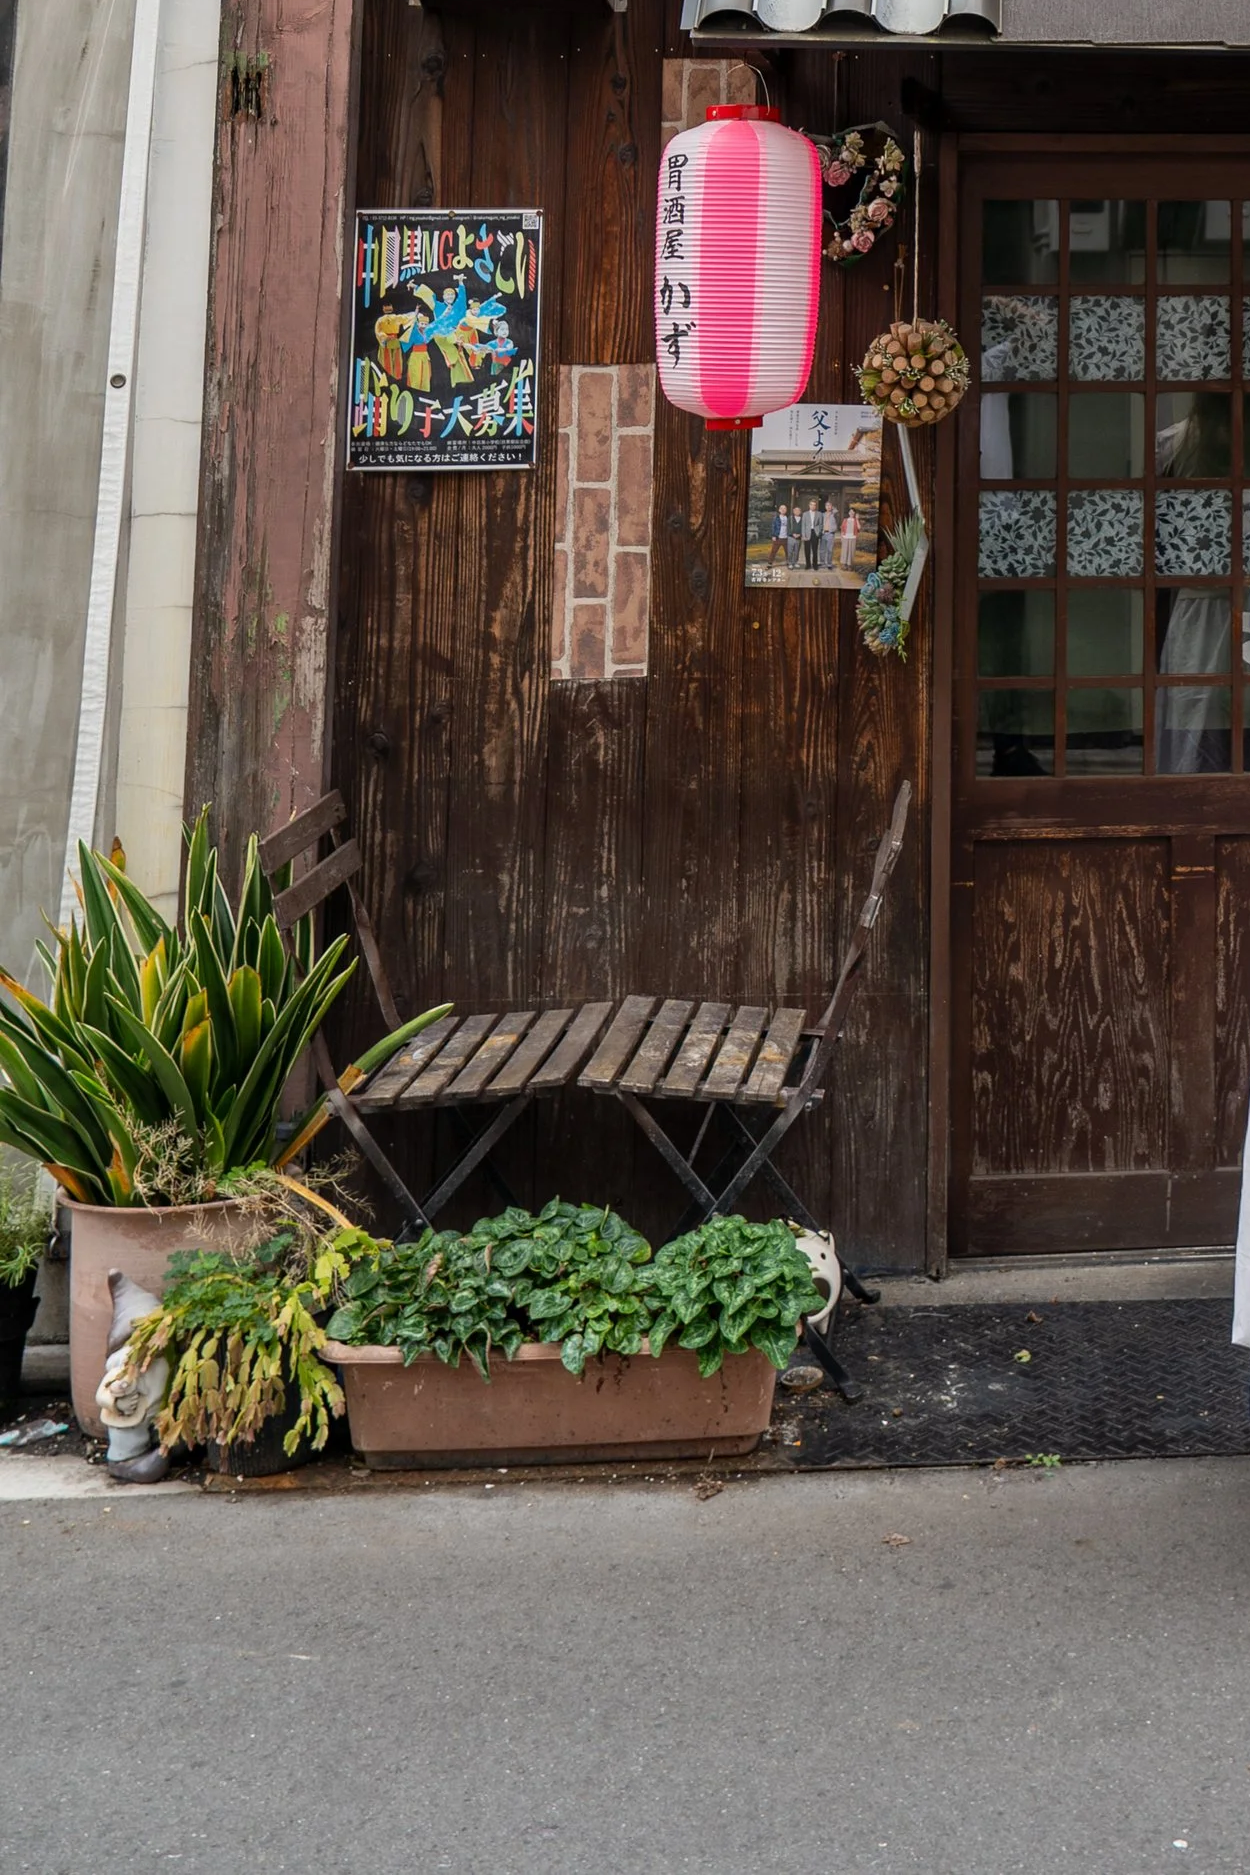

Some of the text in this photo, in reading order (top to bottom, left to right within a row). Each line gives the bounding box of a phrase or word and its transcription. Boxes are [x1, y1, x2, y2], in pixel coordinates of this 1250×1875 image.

[357, 223, 537, 308] 中目黒MGよさこい
[659, 275, 697, 370] かず
[352, 357, 535, 439] 踊り子大募集
